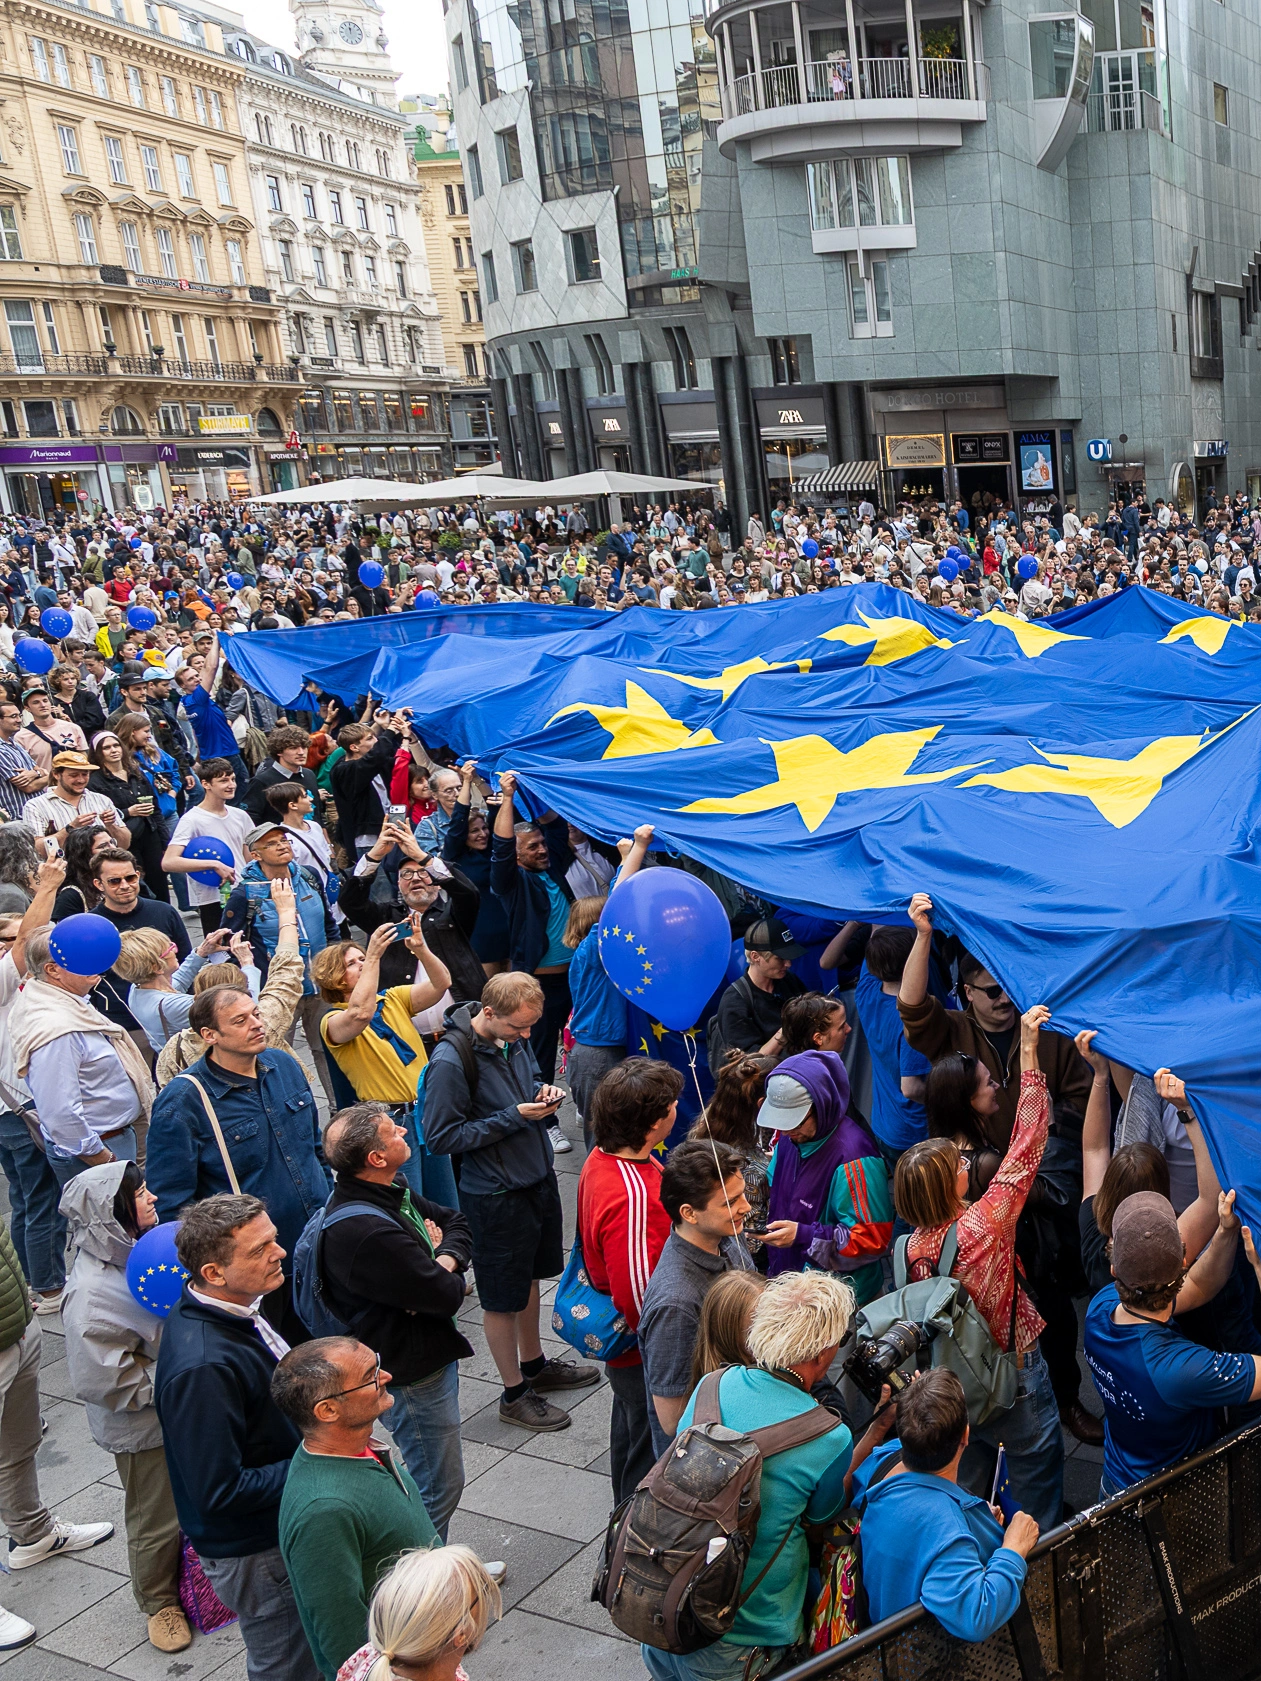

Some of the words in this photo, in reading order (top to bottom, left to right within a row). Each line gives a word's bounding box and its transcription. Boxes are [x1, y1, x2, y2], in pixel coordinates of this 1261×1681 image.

[671, 267, 690, 279] HAAS
[935, 391, 981, 405] HOTEL
[778, 410, 804, 423] ZARA
[603, 418, 621, 431] ZARA
[1020, 433, 1050, 443] ALMAZ
[30, 449, 72, 459] Marionnaud
[1090, 444, 1103, 460] U
[1158, 1541, 1169, 1564] EMAK
[1165, 1562, 1184, 1615] PRODUCTIONS
